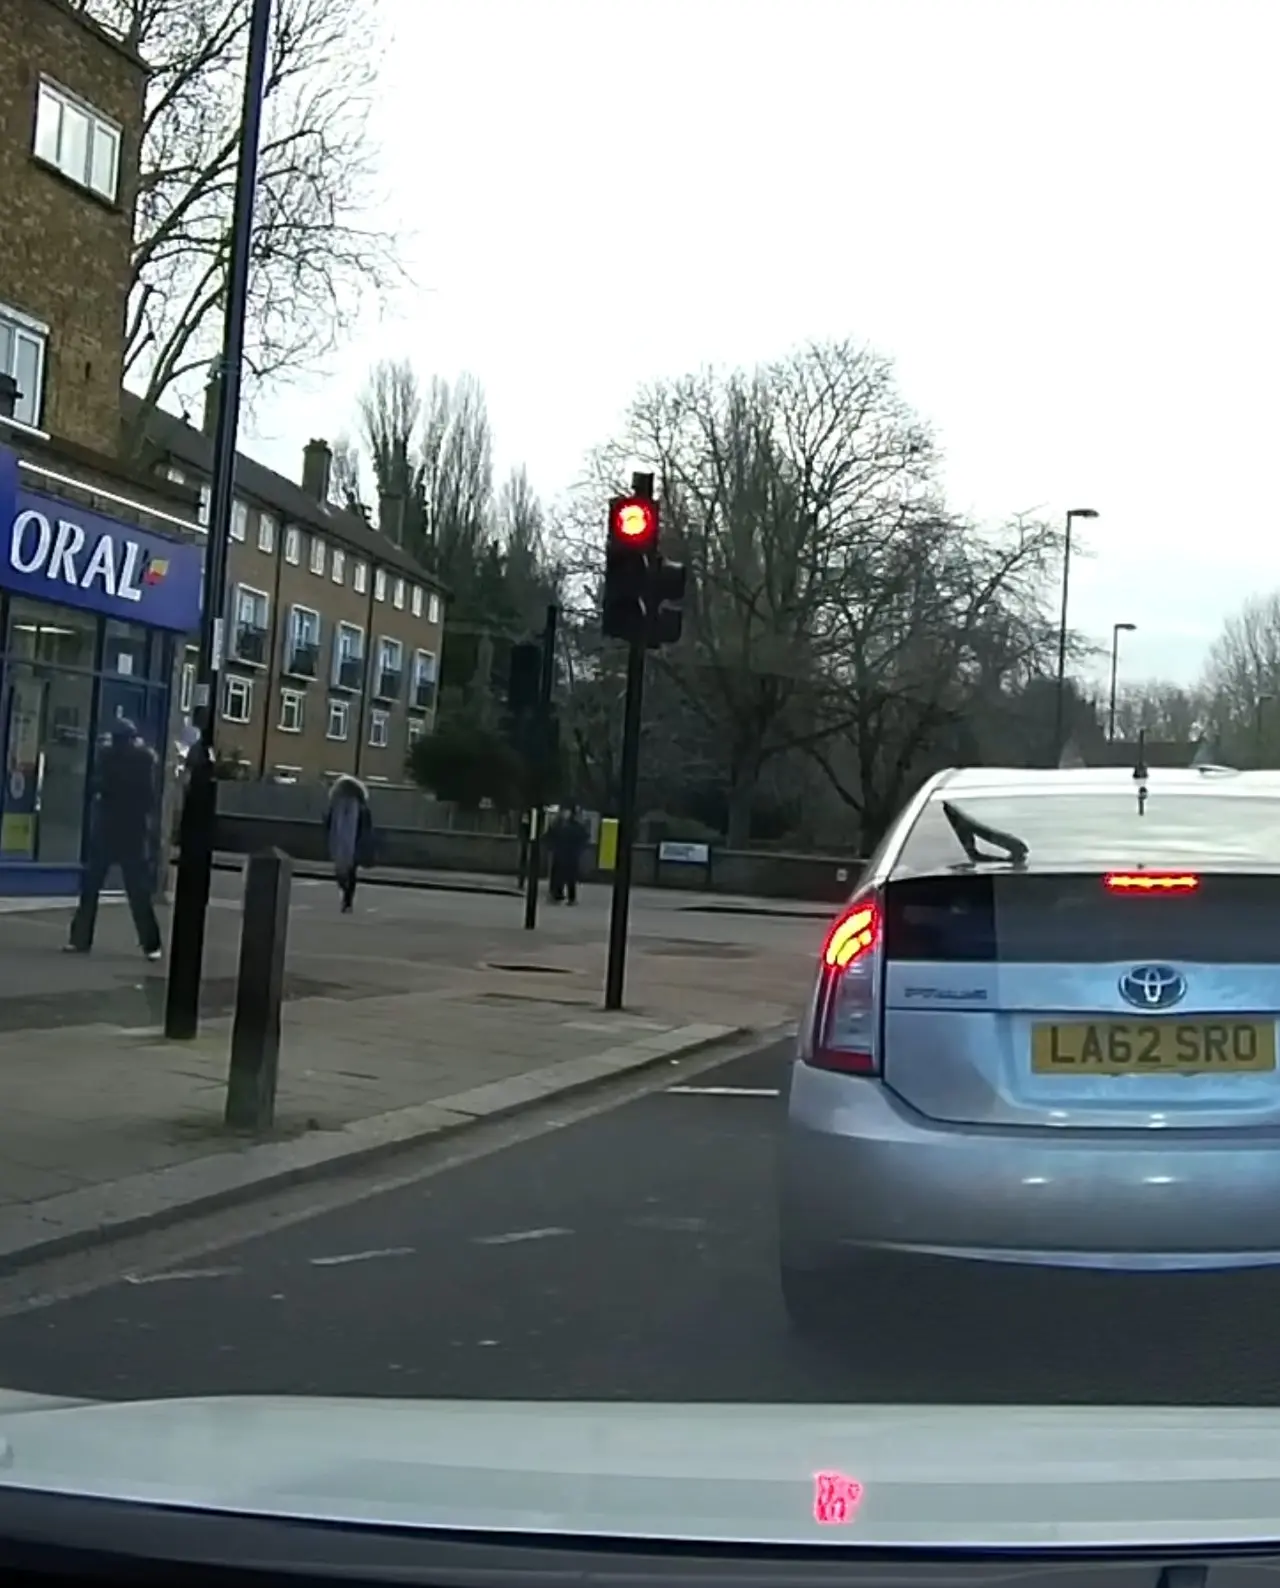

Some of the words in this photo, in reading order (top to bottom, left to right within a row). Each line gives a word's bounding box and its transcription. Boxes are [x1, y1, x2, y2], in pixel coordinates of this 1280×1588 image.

[10, 509, 142, 602] ORAL
[1050, 1025, 1162, 1064] LA62
[1175, 1024, 1257, 1063] SRO
